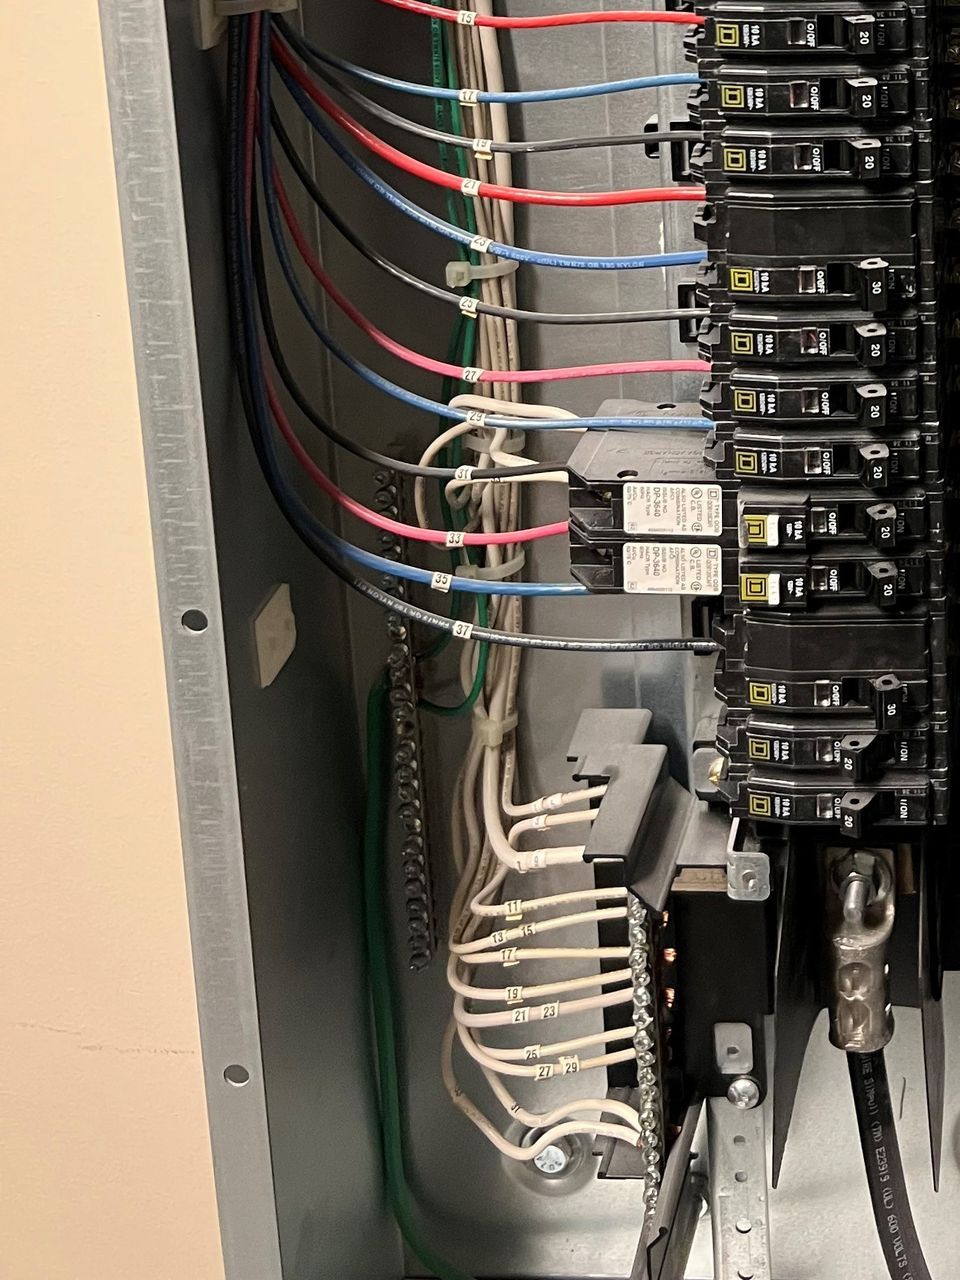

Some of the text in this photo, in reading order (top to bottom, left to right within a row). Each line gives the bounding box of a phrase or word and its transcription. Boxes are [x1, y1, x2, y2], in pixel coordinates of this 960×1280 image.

[460, 13, 472, 23] 15
[860, 32, 869, 44] 20
[462, 91, 474, 102] 17
[862, 95, 871, 108] 20
[476, 139, 488, 150] 19
[865, 156, 874, 169] 20
[464, 179, 476, 191] 21
[872, 282, 881, 294] 30
[461, 298, 473, 308] 25
[871, 344, 880, 356] 20
[464, 371, 477, 380] 27
[470, 412, 482, 421] 29
[871, 406, 879, 418] 20
[874, 467, 882, 478] 20
[653, 487, 661, 517] DP-3640
[881, 527, 890, 538] 20
[449, 534, 460, 544] 33
[436, 575, 447, 584] 35
[884, 584, 892, 596] 20
[457, 624, 469, 635] 37
[888, 704, 896, 715] 30
[845, 758, 852, 770] 20
[845, 815, 853, 827] 20
[507, 902, 520, 912] 11
[521, 925, 534, 936] 15
[493, 932, 504, 943] 13
[502, 949, 512, 959] 17
[508, 989, 518, 999] 19
[515, 1011, 525, 1021] 21
[543, 1006, 555, 1017] 23
[526, 1049, 538, 1060] 25
[538, 1065, 551, 1076] 27
[565, 1061, 578, 1074] 29
[876, 1146, 889, 1182] E23919
[888, 1215, 899, 1233] 600
[893, 1236, 907, 1267] VOLTS
